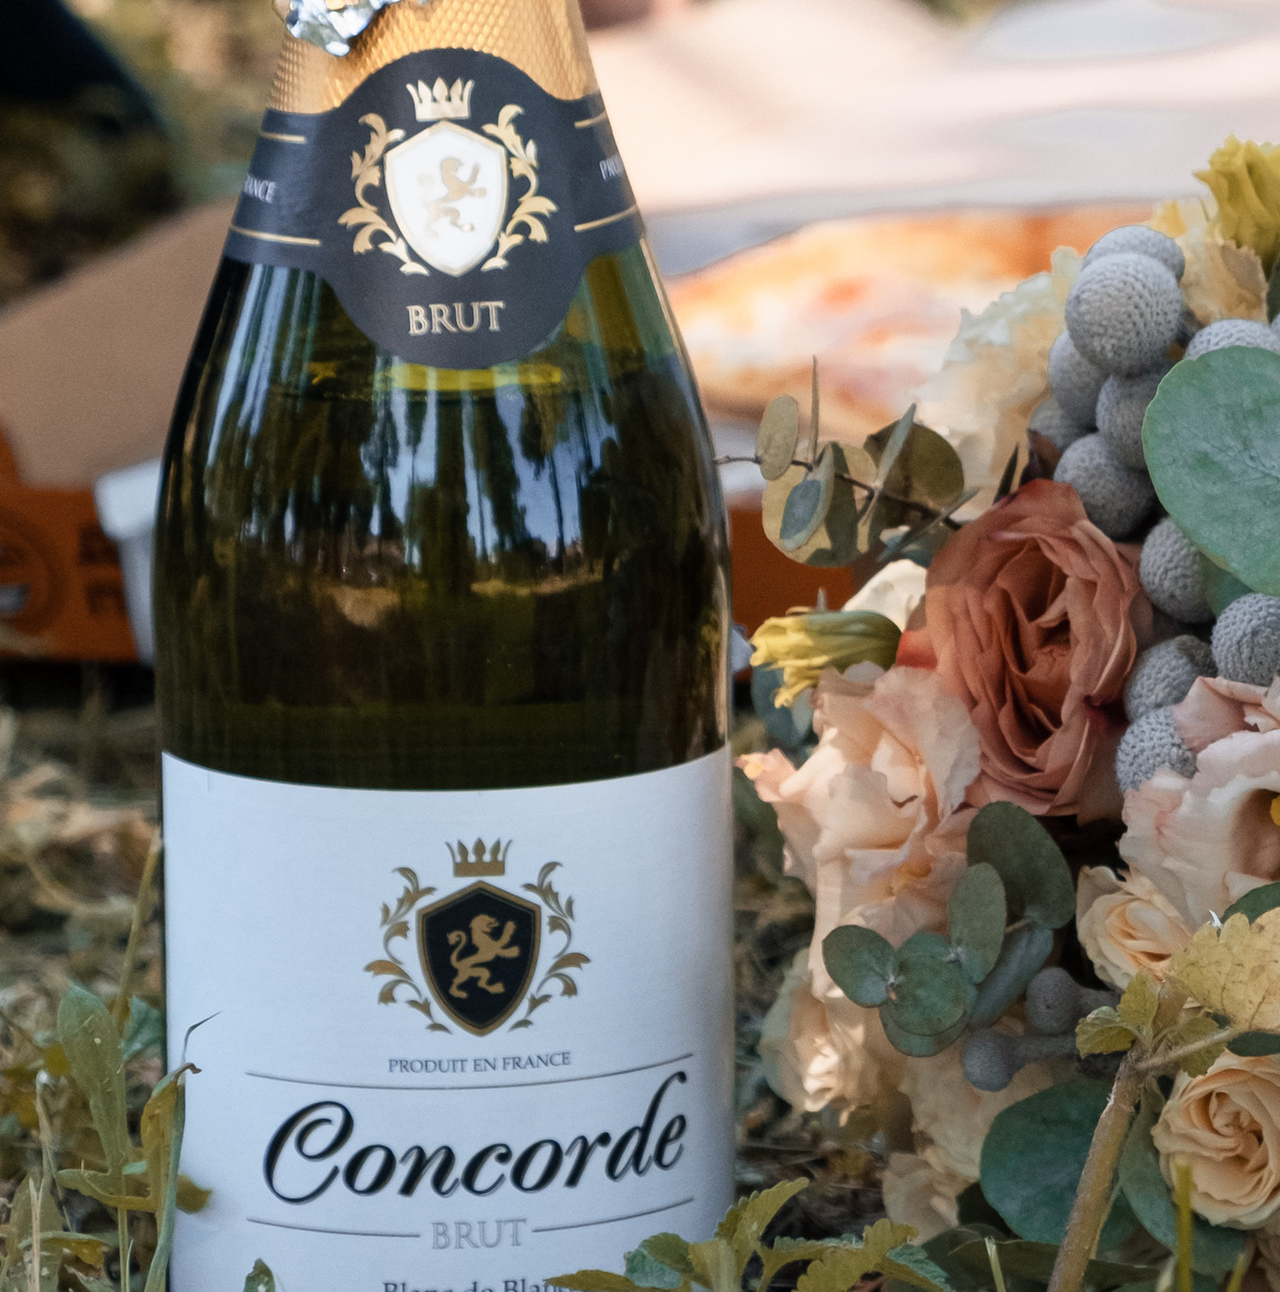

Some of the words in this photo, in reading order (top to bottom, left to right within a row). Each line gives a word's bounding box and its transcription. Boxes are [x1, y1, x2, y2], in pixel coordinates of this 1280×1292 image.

[406, 301, 505, 336] BRUT
[388, 1059, 468, 1073] PRODUIT
[473, 1059, 497, 1072] EN
[502, 1052, 571, 1071] FRANCE
[263, 1071, 688, 1205] Concorde
[431, 1218, 527, 1249] BRUT
